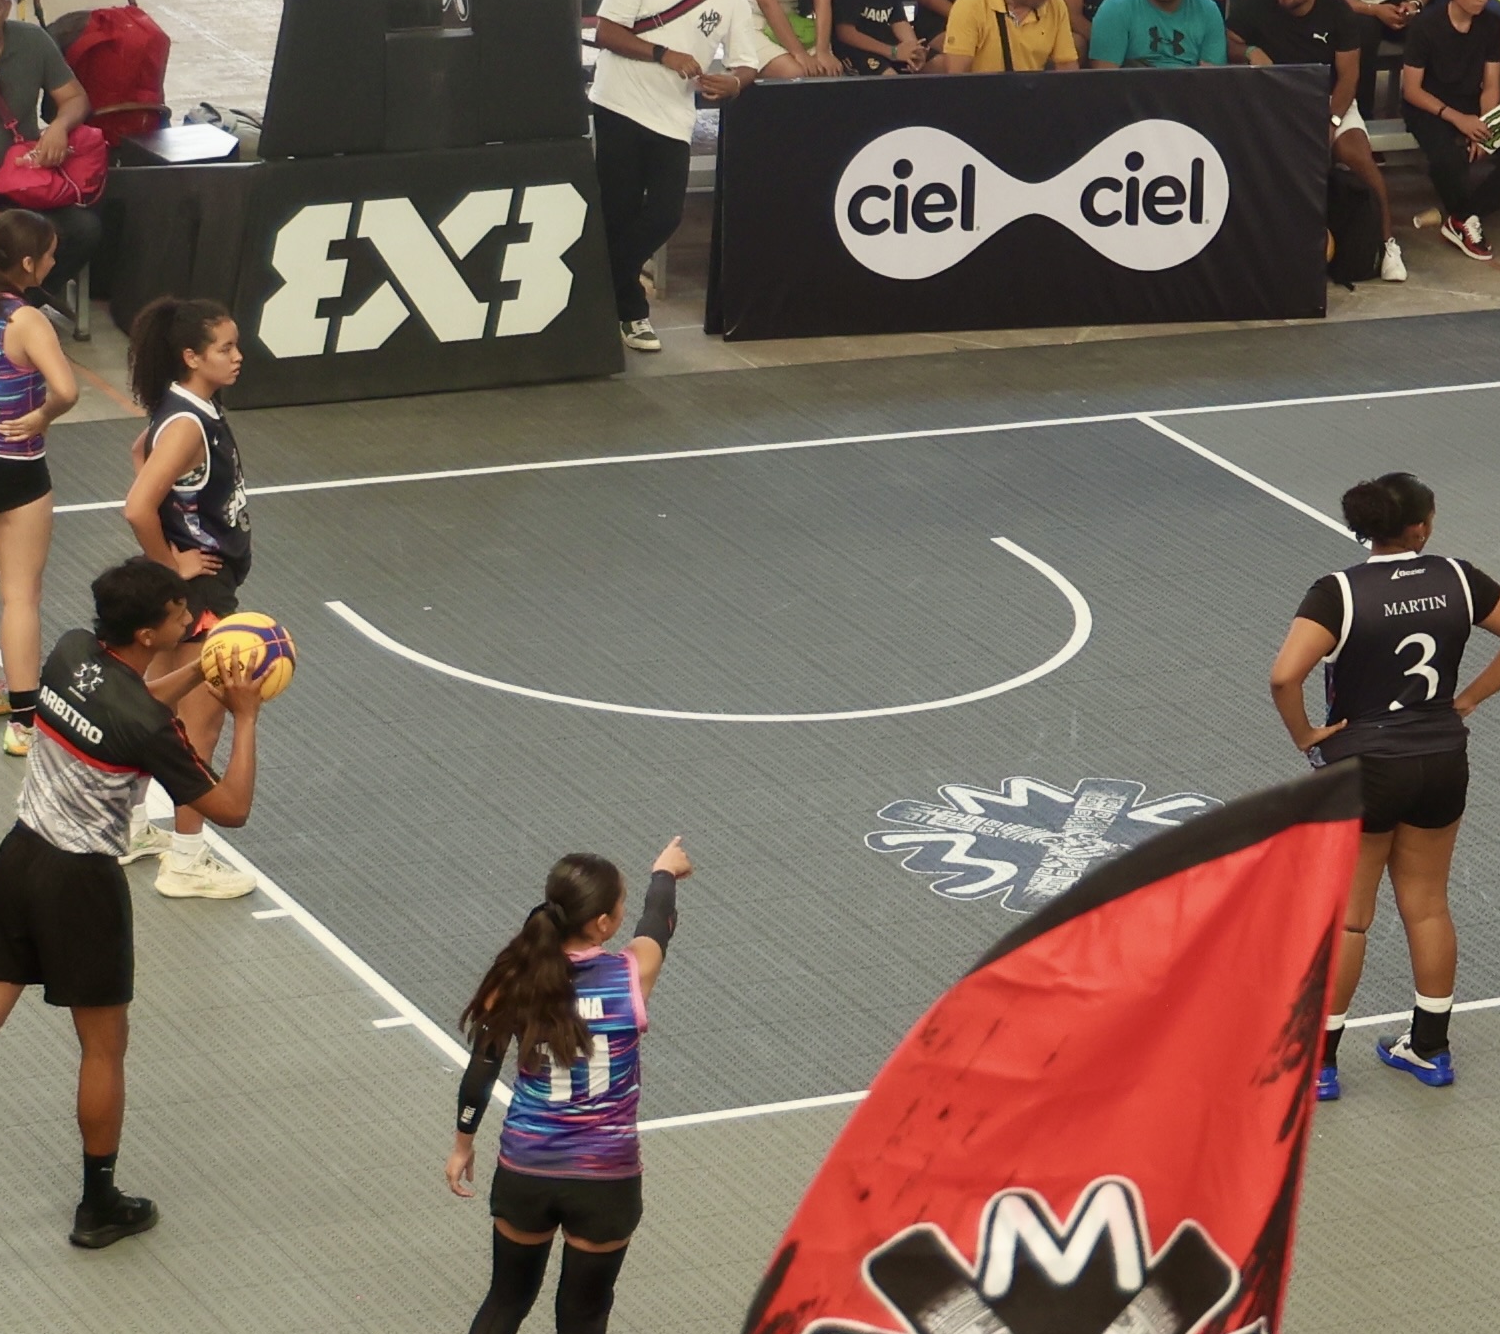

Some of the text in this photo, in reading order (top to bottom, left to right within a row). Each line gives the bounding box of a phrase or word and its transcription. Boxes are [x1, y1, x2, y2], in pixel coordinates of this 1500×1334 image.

[847, 151, 1209, 236] ciel ciel
[1383, 595, 1449, 617] MARTIN
[1388, 632, 1439, 712] 3
[39, 684, 104, 746] ARBITRO
